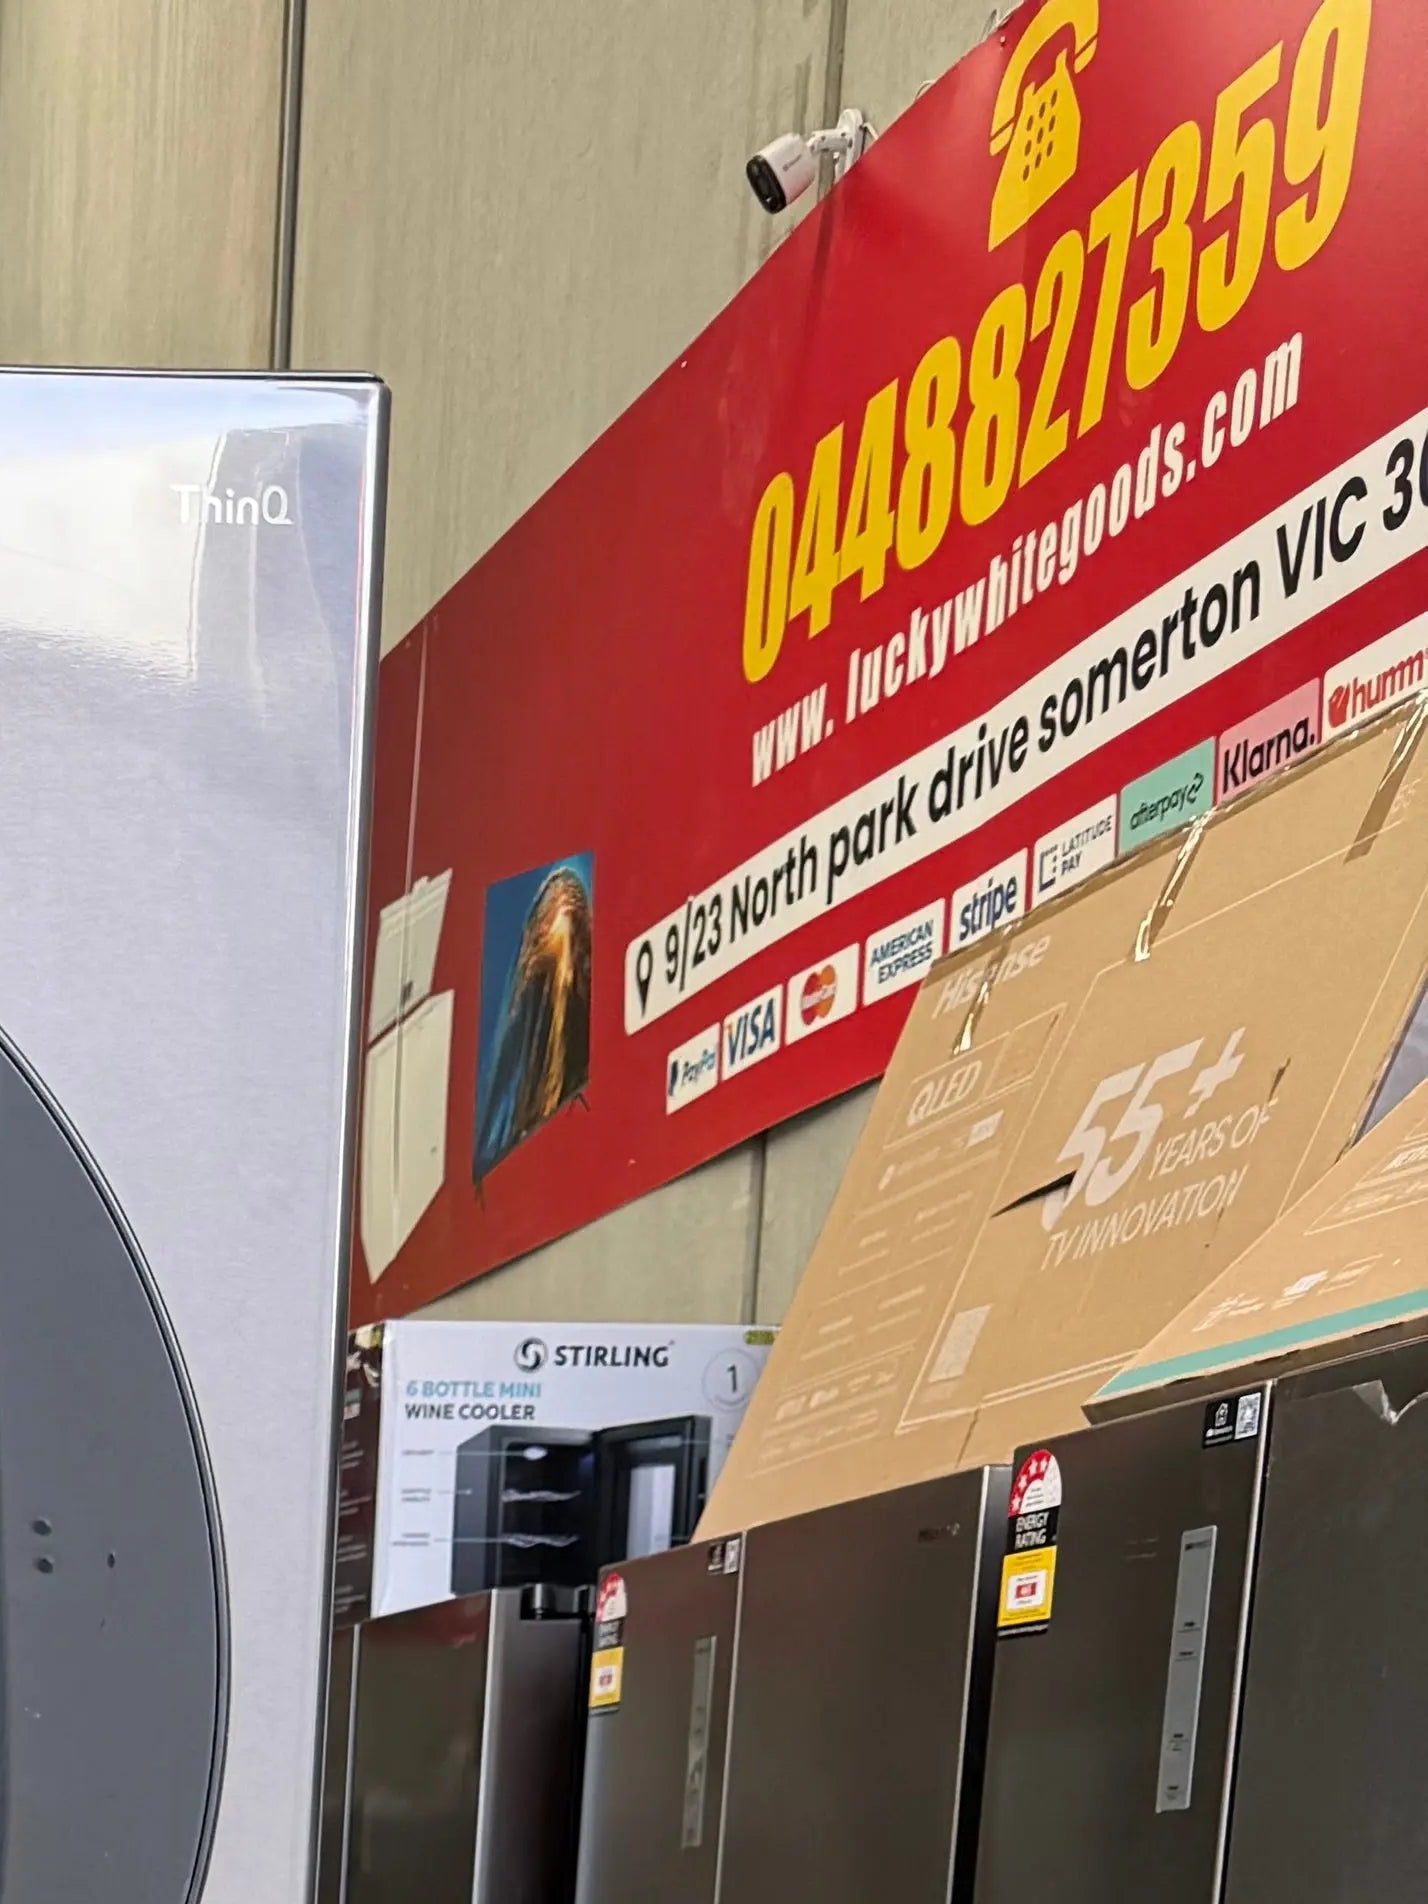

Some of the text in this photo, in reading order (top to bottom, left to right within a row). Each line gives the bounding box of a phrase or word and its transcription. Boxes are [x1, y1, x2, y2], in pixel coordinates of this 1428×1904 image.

[742, 0, 1372, 684] 0448827359
[170, 483, 294, 525] ThinQ
[752, 332, 1303, 787] www. luckywhitegoods.com
[1351, 649, 1424, 719] humm
[665, 893, 723, 991] 9/23
[730, 837, 817, 943] North
[827, 776, 919, 905] park
[928, 717, 1030, 823] drive
[1038, 560, 1262, 753] somerton
[1276, 477, 1369, 598] VIC
[1222, 716, 1316, 795] Klarna.
[1061, 815, 1112, 858] LATITUDE
[1129, 787, 1187, 831] afterpay
[1061, 854, 1082, 876] PAY
[959, 873, 1017, 942] stripe
[870, 919, 934, 968] AMERICAN
[877, 943, 934, 985] EXPRESS
[728, 997, 776, 1066] VISA
[1041, 1027, 1245, 1231] 55+
[1148, 1096, 1278, 1181] YEARS OF
[1041, 1226, 1079, 1271] TV
[1073, 1162, 1250, 1260] INNOVATION
[406, 1381, 542, 1400] 6 BOTTLE MINI
[553, 1345, 670, 1368] STIRLING
[404, 1403, 536, 1421] WINE COOLER
